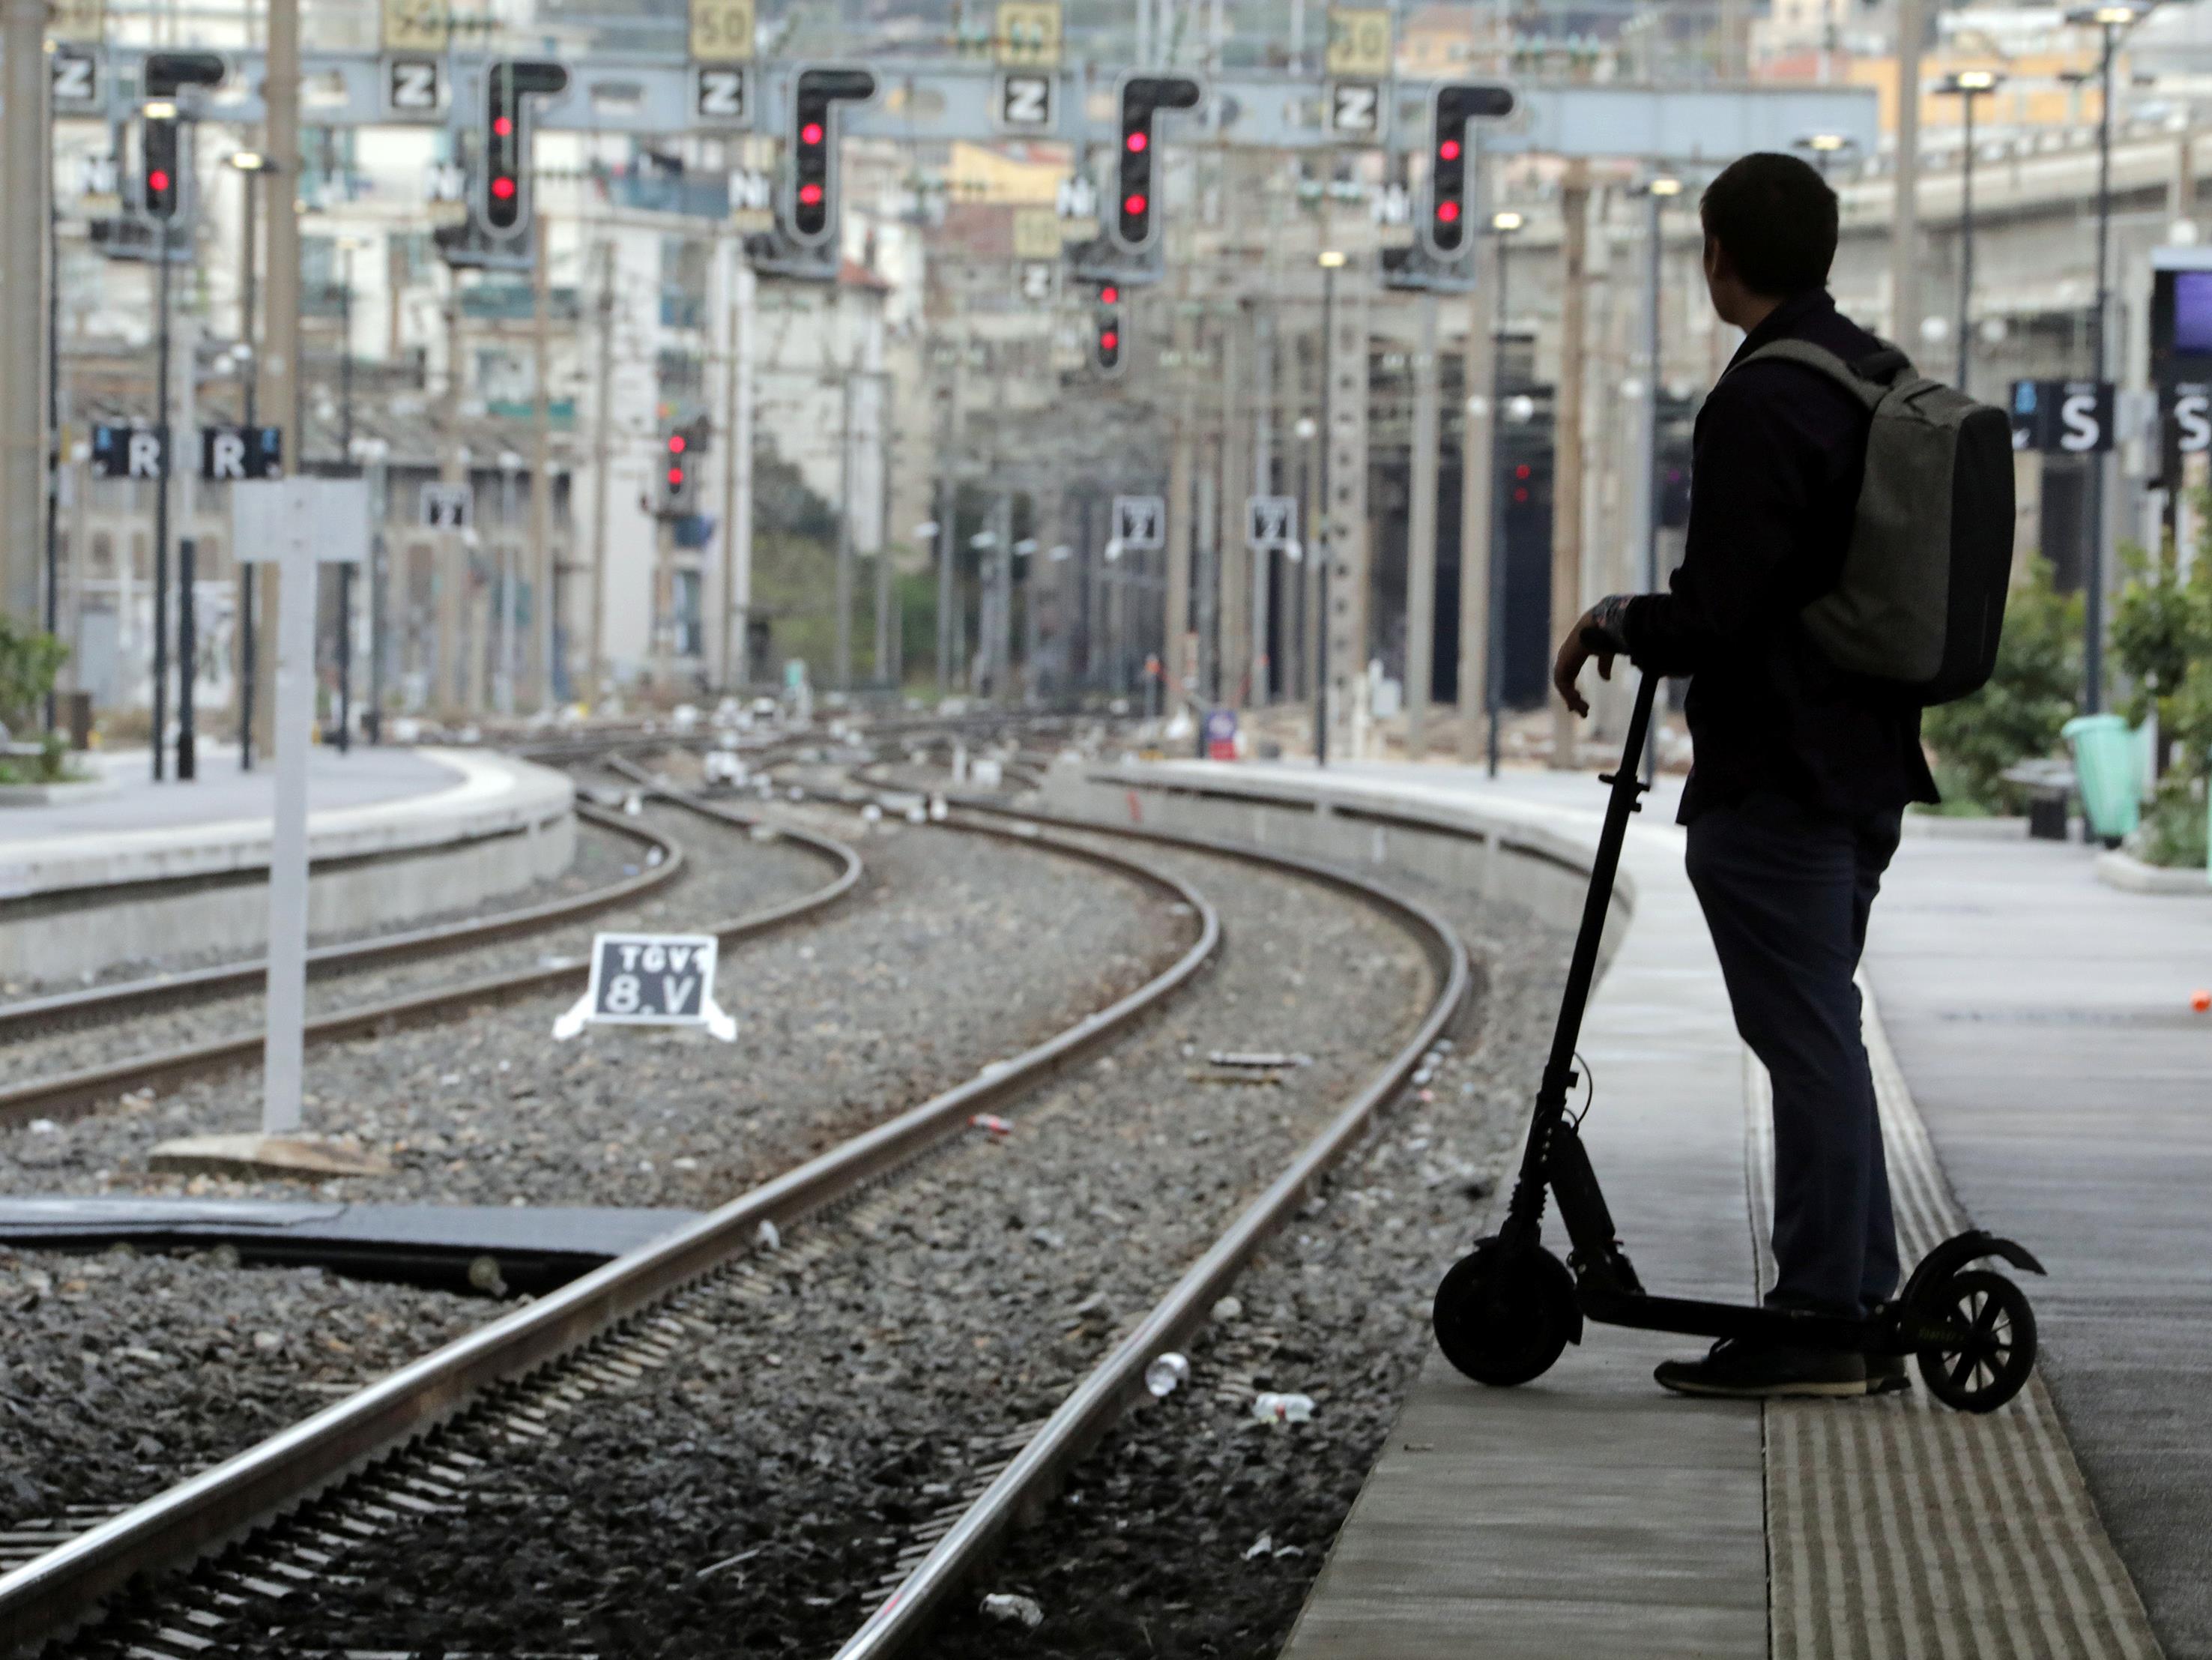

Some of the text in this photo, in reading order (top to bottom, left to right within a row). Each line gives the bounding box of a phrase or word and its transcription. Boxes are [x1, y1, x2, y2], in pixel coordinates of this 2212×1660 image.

[394, 65, 433, 105] Z
[701, 73, 740, 113] Z
[1006, 80, 1045, 121] Z
[1338, 88, 1376, 127] Z
[2061, 396, 2100, 451] S
[2174, 396, 2211, 451] S
[129, 432, 161, 478] R
[214, 432, 246, 478] R
[619, 946, 692, 974] TGV
